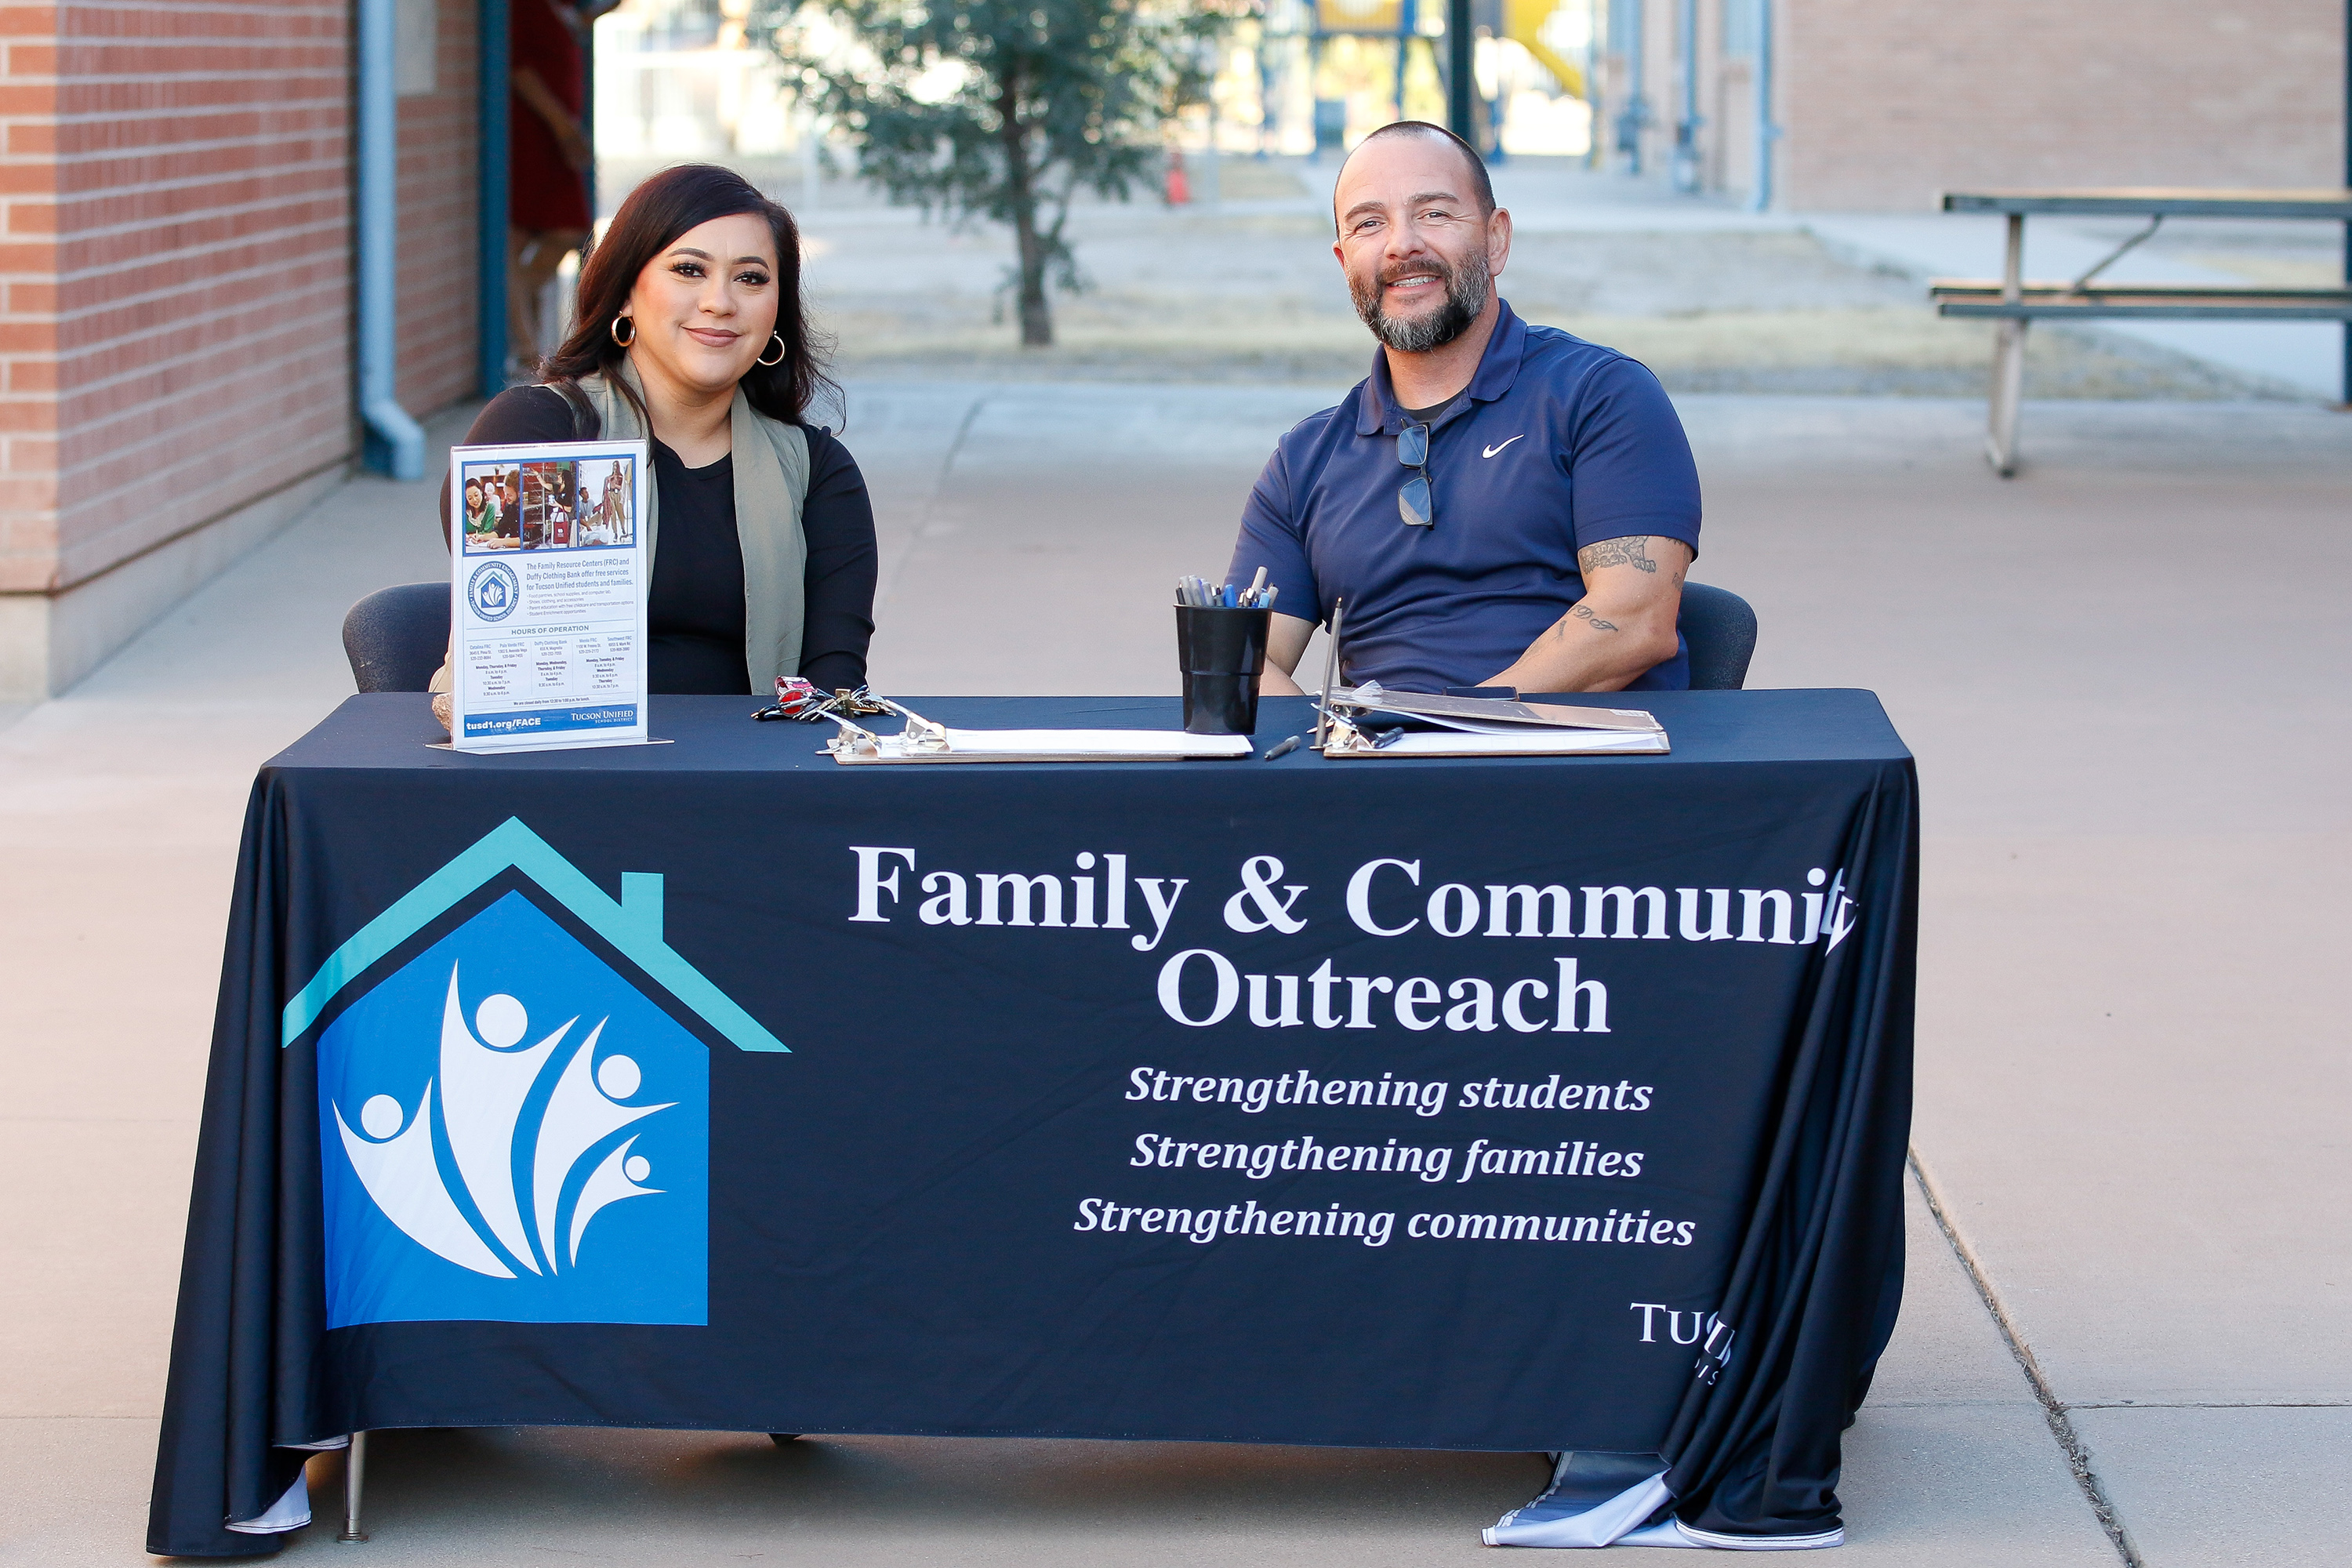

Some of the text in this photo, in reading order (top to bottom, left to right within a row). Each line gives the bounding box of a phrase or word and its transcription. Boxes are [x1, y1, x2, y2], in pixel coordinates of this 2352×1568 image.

[476, 563, 502, 575] COMMUNITY
[466, 718, 541, 730] tusd1.org/FACE
[572, 713, 601, 721] TUCSON
[848, 847, 1189, 953] Family
[1224, 856, 1308, 934] &
[1158, 949, 1611, 1033] Outreach
[1125, 1067, 1653, 1116] Strengthening students
[1131, 1134, 1644, 1182] Strengthening families
[1074, 1199, 1695, 1247] Strengthening communities
